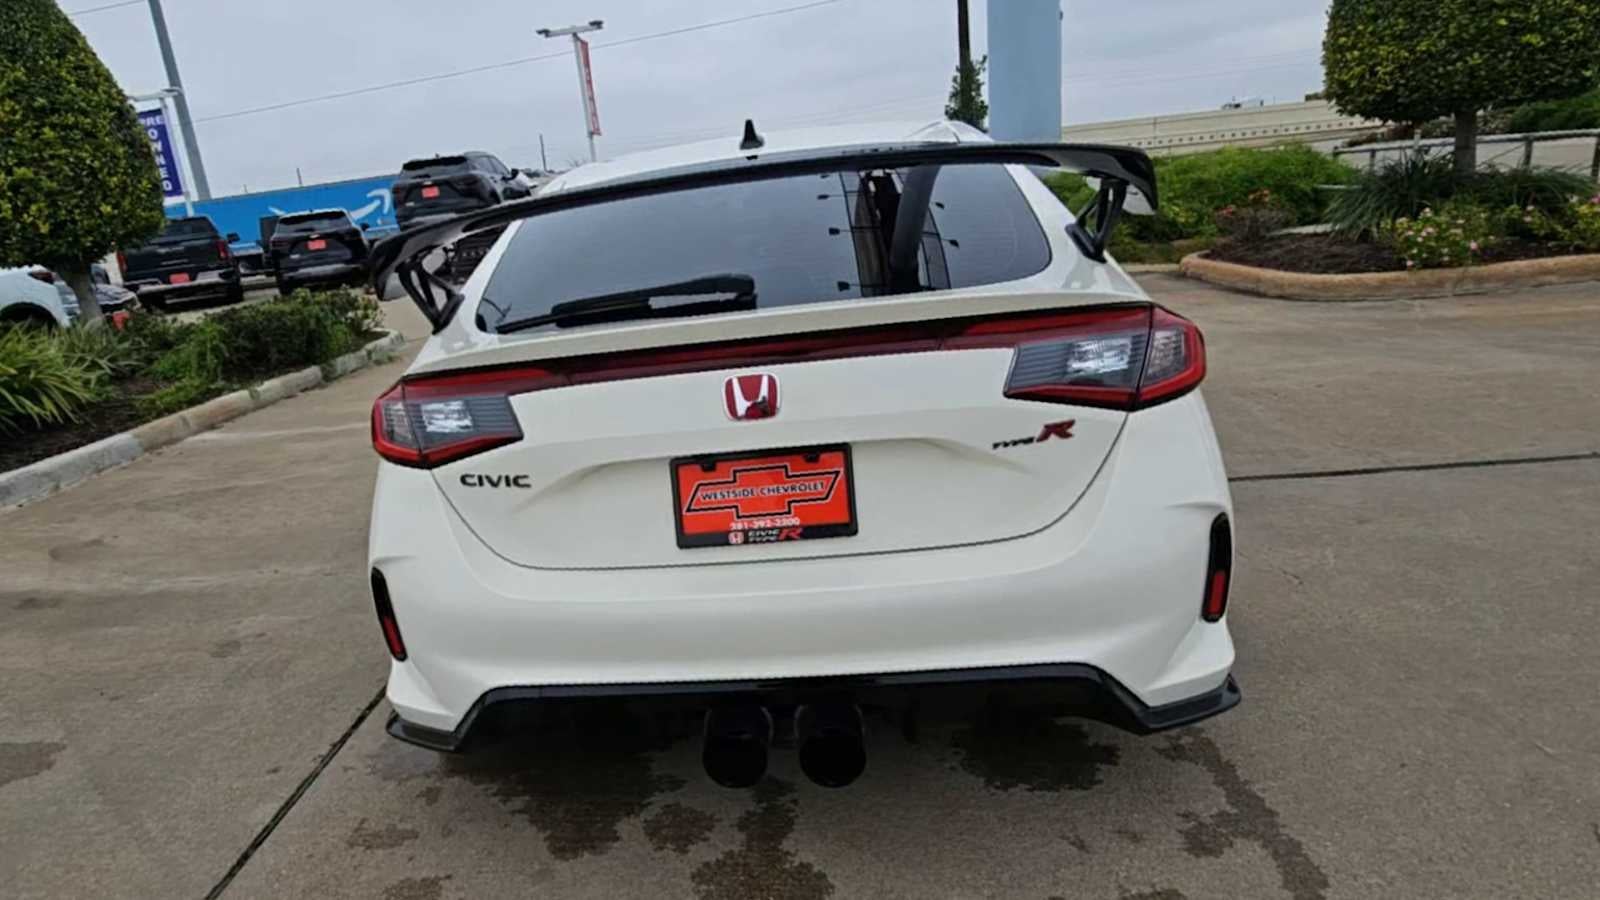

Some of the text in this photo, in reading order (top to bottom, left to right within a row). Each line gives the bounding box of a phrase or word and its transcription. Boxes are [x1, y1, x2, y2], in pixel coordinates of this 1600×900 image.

[992, 418, 1076, 450] TYPE R
[460, 474, 532, 488] CIVIC
[701, 482, 824, 501] WESTSIDE CHEVROLET
